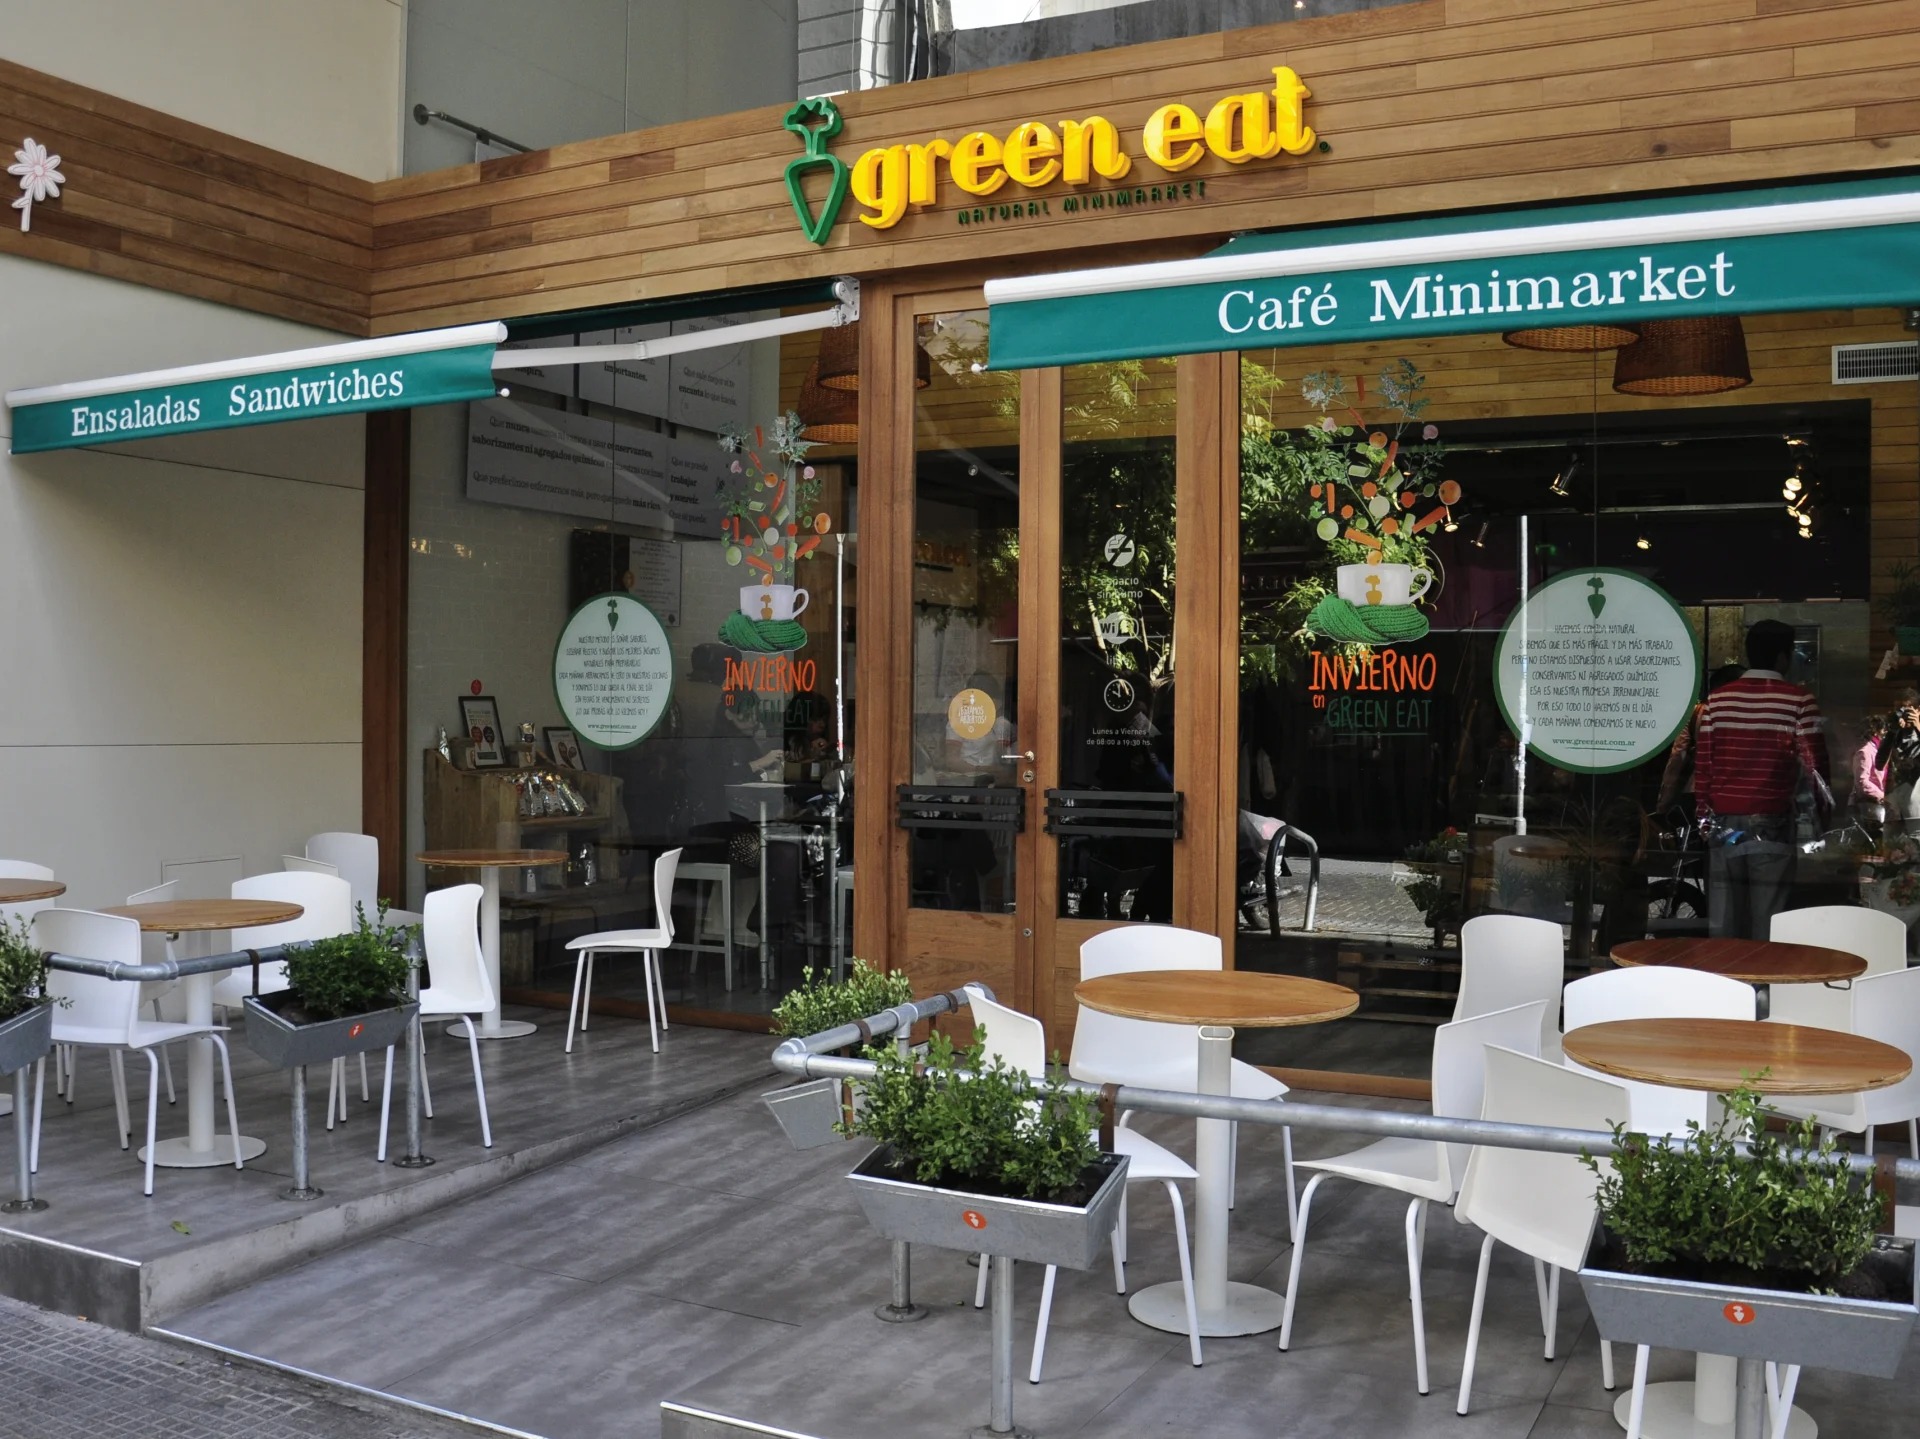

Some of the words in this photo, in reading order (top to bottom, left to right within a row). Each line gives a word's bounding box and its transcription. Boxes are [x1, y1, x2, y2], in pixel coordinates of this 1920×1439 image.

[851, 115, 1131, 230] green
[1143, 66, 1317, 172] eat
[958, 200, 1050, 226] NATURAL
[1064, 180, 1206, 212] MINIMARKET
[1218, 289, 1338, 334] Café
[1370, 252, 1735, 322] Minimarket
[678, 385, 704, 398] encanta
[72, 396, 200, 437] Ensaladas
[228, 369, 404, 416] Sandwiches
[505, 421, 530, 433] nunca
[472, 434, 524, 452] saborizantes
[524, 444, 533, 454] ni
[534, 448, 572, 462] agregados
[671, 475, 698, 488] trabajar
[473, 470, 488, 482] Que
[489, 473, 530, 489] preferimos
[632, 498, 646, 508] más
[1100, 577, 1140, 588] espacio
[1096, 590, 1111, 600] sin
[1554, 624, 1581, 634] HACEMOS
[1583, 624, 1607, 634] COMIDA
[1519, 640, 1547, 650] SBEMOS
[1549, 640, 1560, 650] QUE
[1562, 640, 1571, 650] ES
[1572, 637, 1586, 650] MÁS
[1588, 637, 1609, 650] FRÁGIL
[1618, 640, 1627, 650] DA
[1628, 637, 1642, 650] MÁS
[1645, 640, 1673, 650] TRABAJO
[1528, 655, 1538, 666] NO
[1539, 655, 1567, 666] ESTAMOS
[1568, 655, 1605, 666] DISPUESTOS
[1615, 655, 1631, 666] USAR
[722, 656, 816, 694] INVIERNO
[1308, 648, 1437, 692] INVIERNO
[1532, 670, 1576, 681] CONSERVANTES
[1578, 670, 1587, 681] NI
[1588, 670, 1624, 681] AGREGADOS
[1530, 686, 1542, 698] ESA
[1544, 686, 1551, 698] ES
[1553, 686, 1580, 698] NUESTRA
[1582, 686, 1610, 698] PROMESA
[1313, 693, 1325, 708] en
[1326, 696, 1388, 728] GREEN
[1397, 700, 1432, 728] EAT
[1537, 701, 1549, 712] POR
[1552, 701, 1563, 712] ESO
[1566, 701, 1581, 712] TODO
[1583, 701, 1591, 712] LO
[1593, 701, 1620, 712] HACEMOS
[1622, 701, 1630, 712] EN
[1632, 701, 1639, 712] EL
[1641, 700, 1652, 712] DÍA
[1538, 717, 1554, 728] CADA
[1555, 714, 1582, 728] MAÑANA
[1583, 717, 1624, 728] COMENZAMOS
[1626, 717, 1634, 728] DE
[1120, 728, 1147, 736] Viernes
[1086, 738, 1095, 746] de
[1552, 738, 1636, 747] www.greeneat.com.ar
